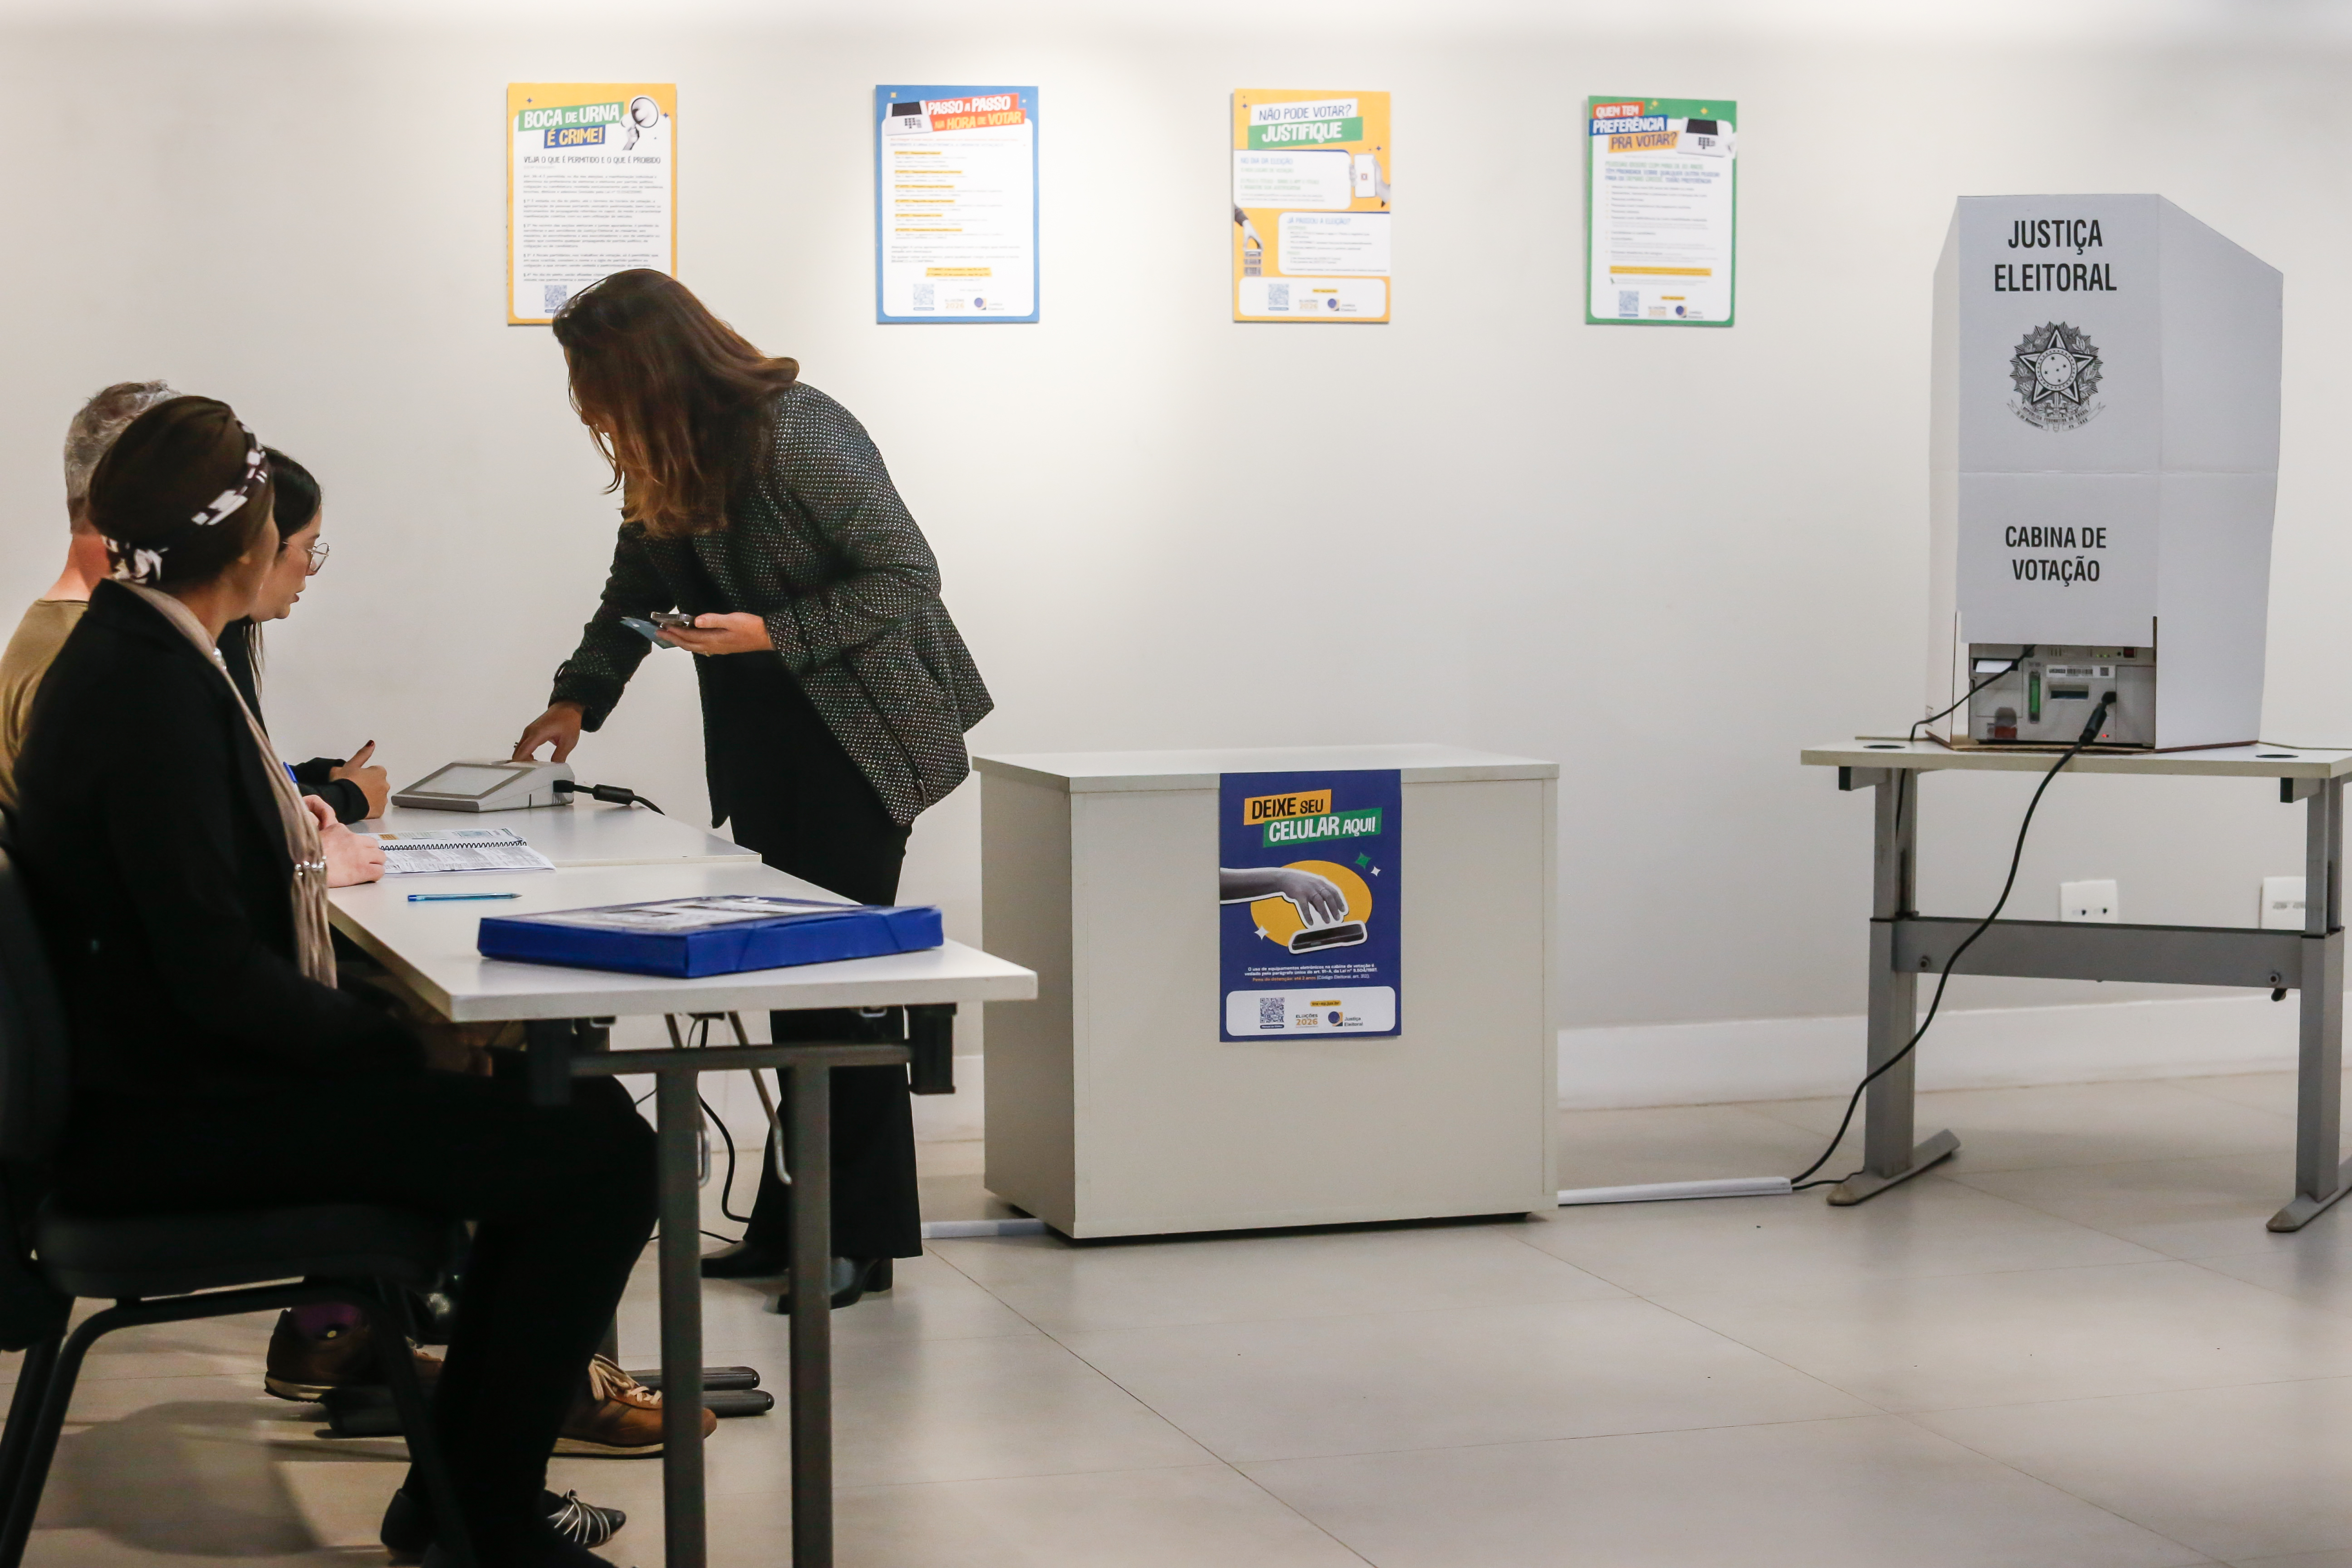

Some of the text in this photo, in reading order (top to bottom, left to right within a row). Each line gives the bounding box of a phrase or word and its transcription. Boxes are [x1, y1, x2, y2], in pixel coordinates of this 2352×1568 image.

[524, 103, 620, 128] BOCA DE URNA
[927, 96, 1011, 116] PASSO A PASSO
[1259, 104, 1351, 121] NÃO PODE VOTAR?
[1596, 104, 1639, 119] QUEM TEM
[946, 116, 976, 130] HORA
[988, 111, 1022, 125] VOTAR
[1592, 116, 1666, 134] PREFERÊNCIA
[547, 127, 603, 146] É CRIME!
[1261, 121, 1343, 144] JUSTIFIQUE
[1611, 131, 1678, 150] PRA VOTAR?
[548, 156, 560, 165] QUE
[613, 156, 626, 165] QUE
[628, 155, 631, 164] É
[2008, 219, 2103, 255] JUSTIÇA
[1994, 263, 2117, 292] ELEITORAL
[2005, 525, 2107, 549] CABINA DE
[2012, 554, 2101, 587] VOTAÇÃO
[1252, 797, 1324, 820] DEIXE SEU
[1269, 816, 1376, 843] CELULAR AQUI!
